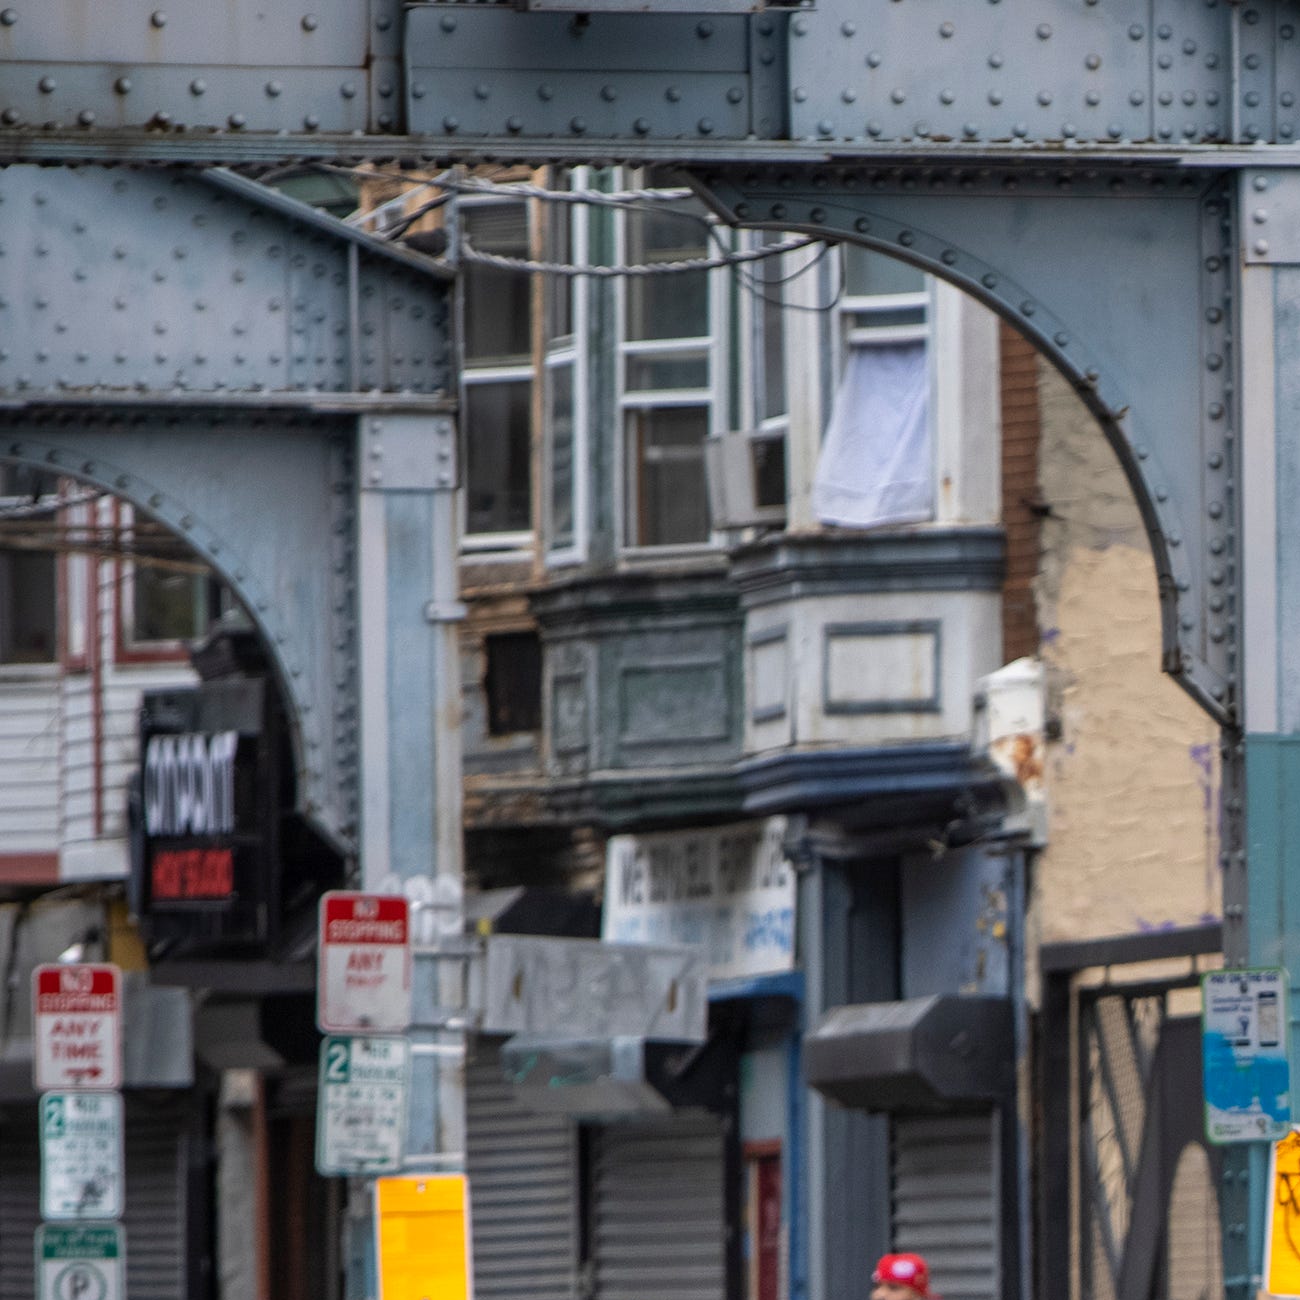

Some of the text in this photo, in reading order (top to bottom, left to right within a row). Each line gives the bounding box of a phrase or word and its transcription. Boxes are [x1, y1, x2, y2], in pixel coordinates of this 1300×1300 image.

[50, 1019, 100, 1037] ANY
[49, 1042, 101, 1060] TIME
[328, 1044, 348, 1079] 2
